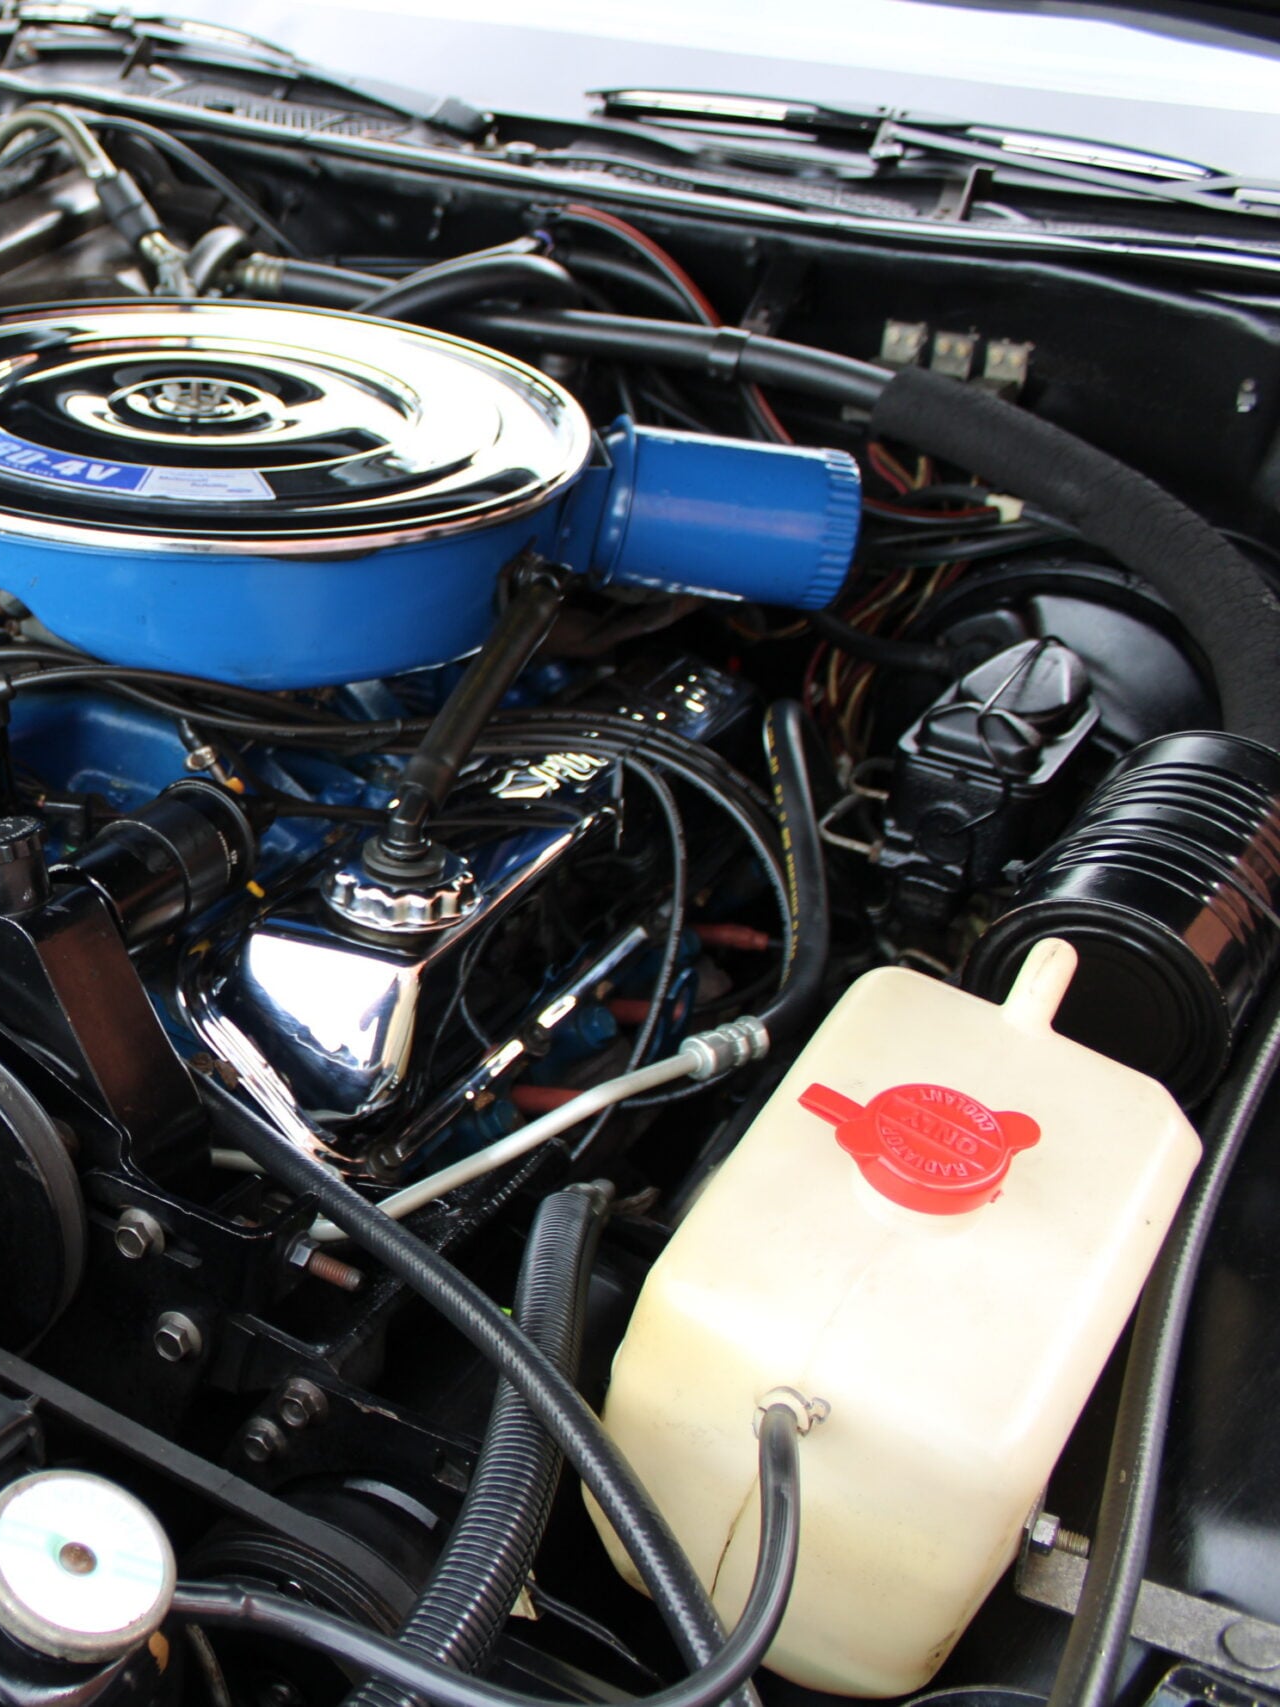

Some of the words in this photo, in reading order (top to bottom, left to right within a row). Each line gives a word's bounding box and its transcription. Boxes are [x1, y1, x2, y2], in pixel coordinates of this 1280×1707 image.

[901, 1110, 978, 1155] ONLY
[919, 1088, 996, 1132] COOLANT
[881, 1125, 969, 1178] RADIATOR
